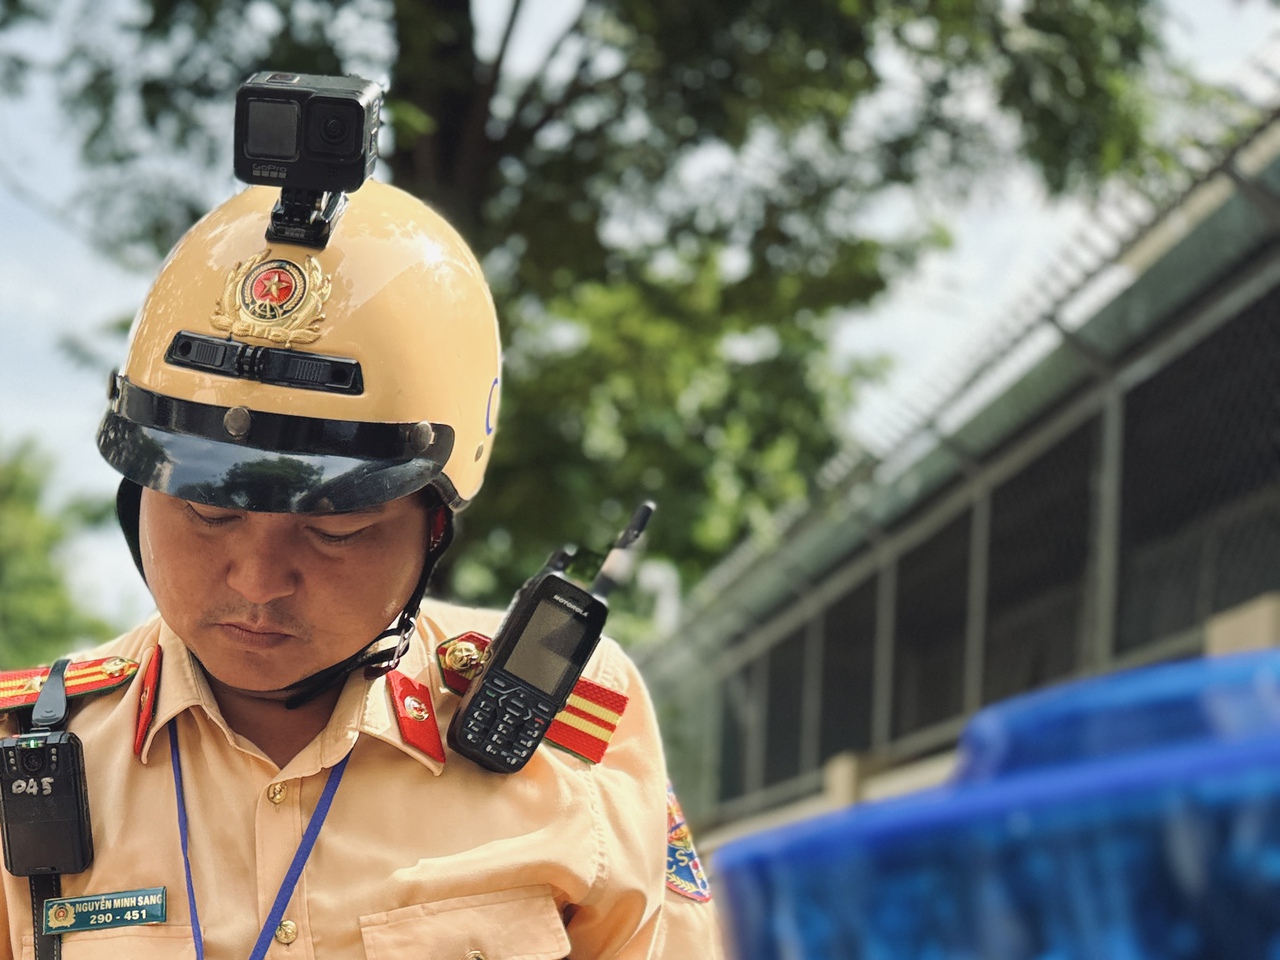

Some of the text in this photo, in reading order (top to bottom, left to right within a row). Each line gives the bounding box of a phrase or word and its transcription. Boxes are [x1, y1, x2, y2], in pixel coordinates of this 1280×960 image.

[252, 163, 287, 173] GoPro
[552, 594, 589, 617] MOTOROLA
[113, 896, 136, 909] MINH
[137, 894, 162, 906] SANG
[90, 913, 113, 925] 290
[124, 909, 147, 921] 451
